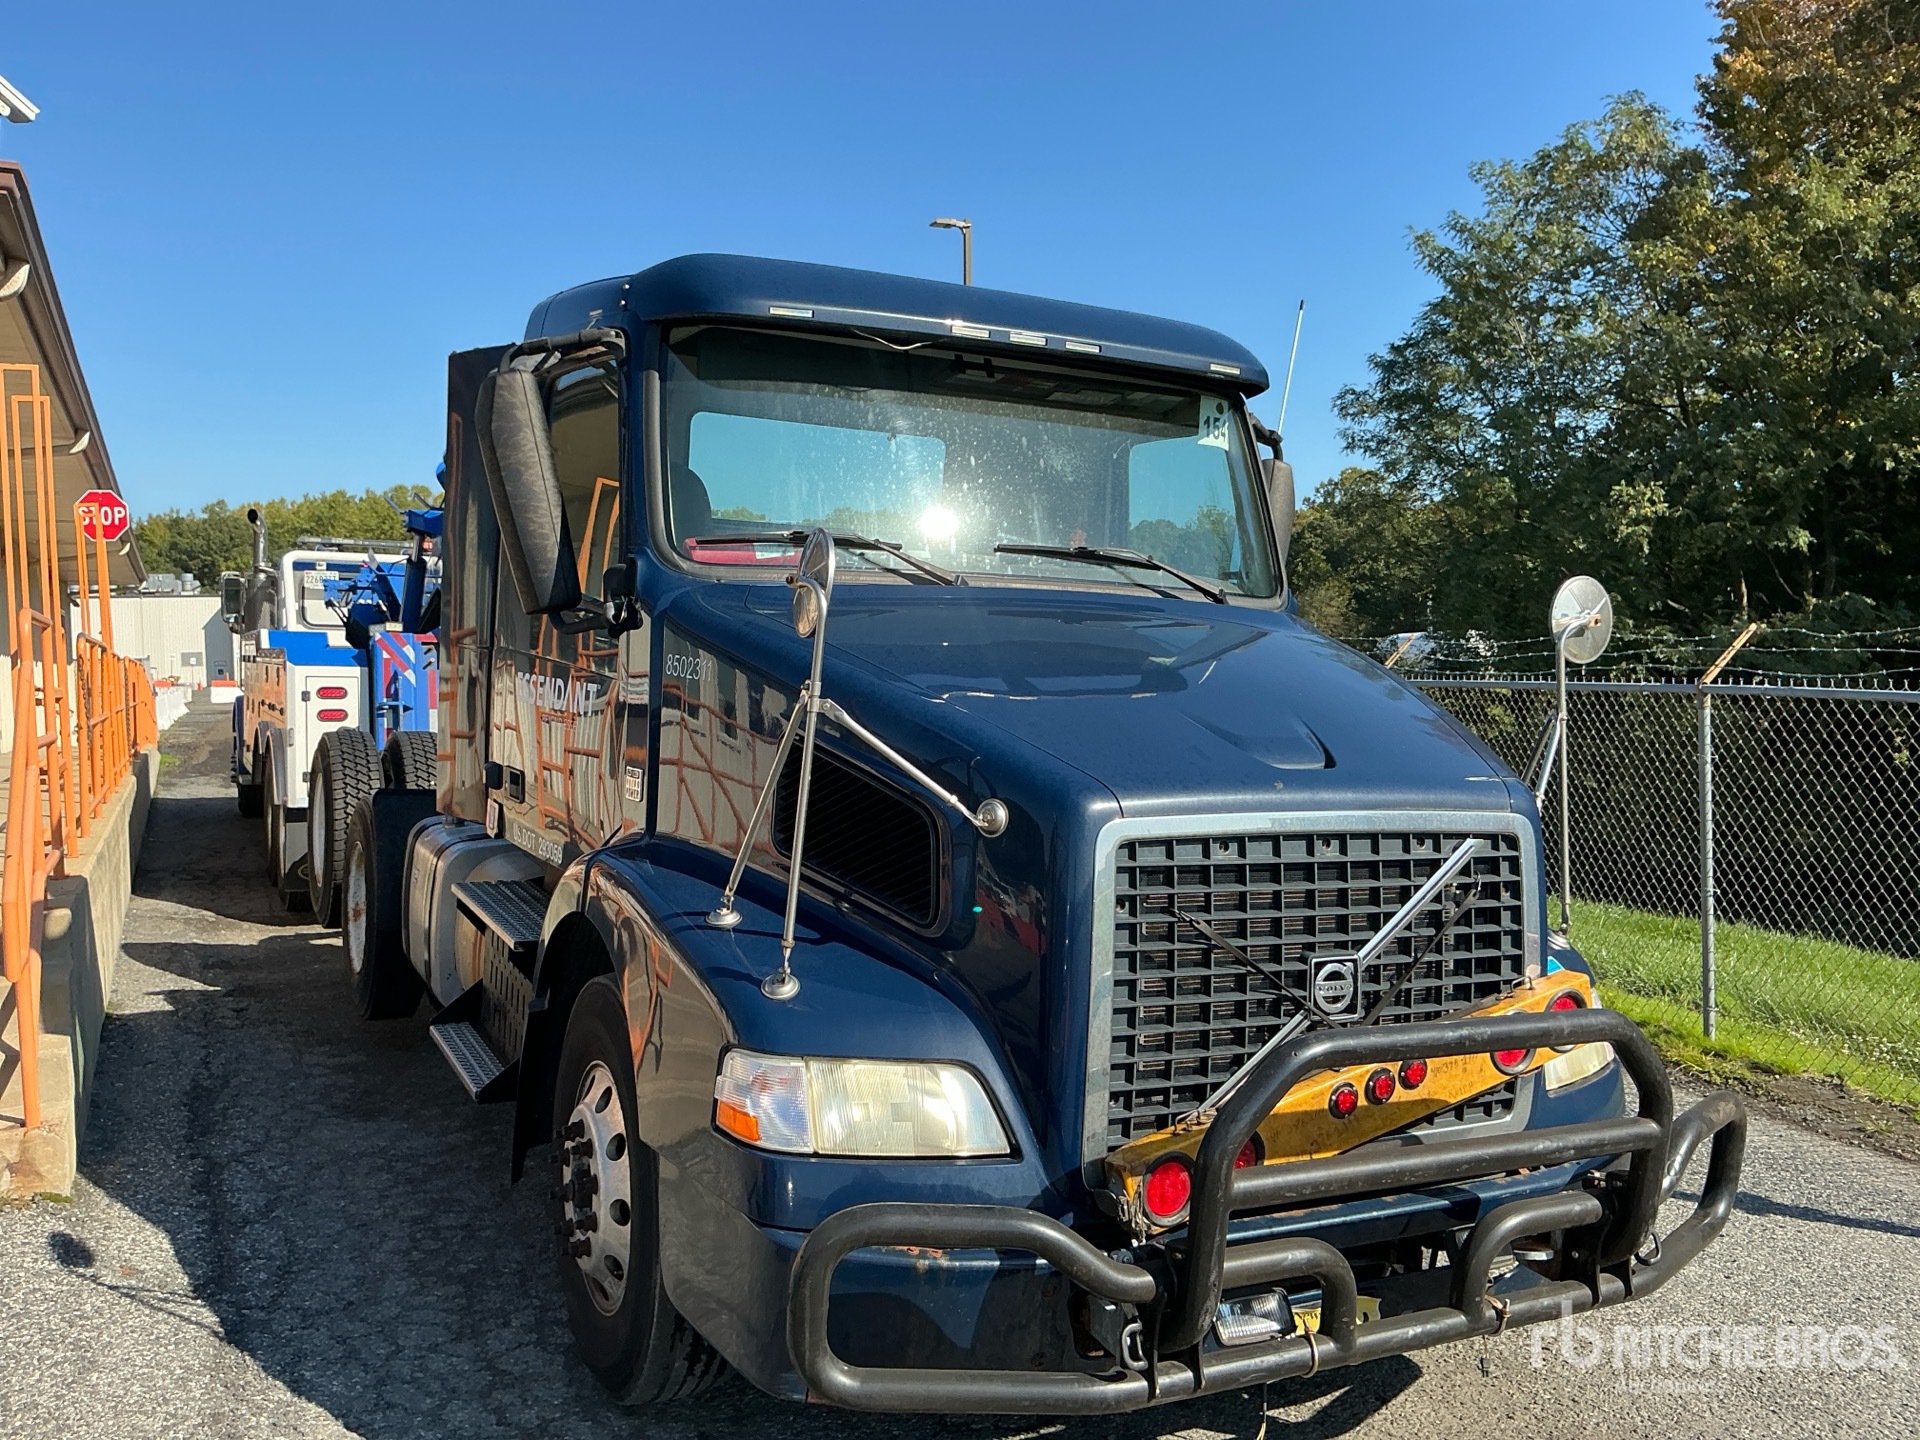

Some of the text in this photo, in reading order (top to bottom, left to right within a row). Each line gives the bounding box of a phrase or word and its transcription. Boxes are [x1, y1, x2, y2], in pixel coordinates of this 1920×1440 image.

[78, 506, 126, 526] STOP
[665, 653, 713, 682] 8502311
[516, 671, 597, 717] ESSENDANT
